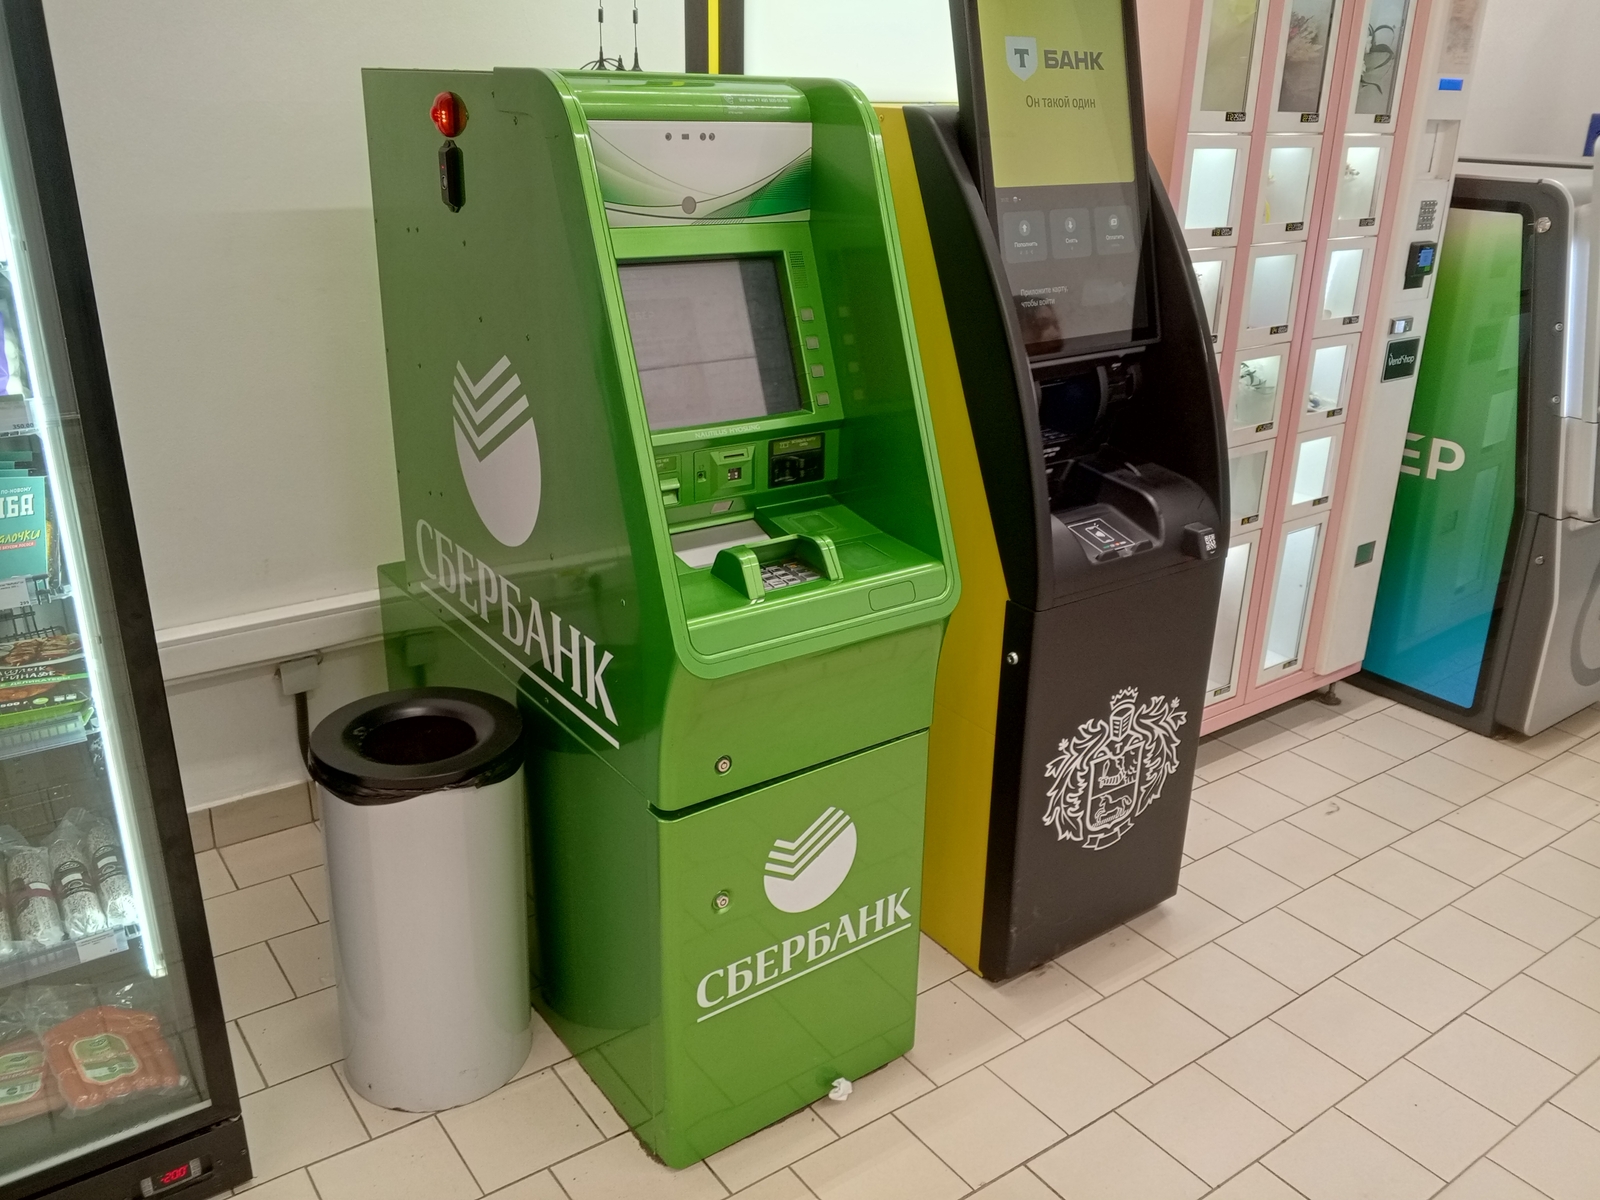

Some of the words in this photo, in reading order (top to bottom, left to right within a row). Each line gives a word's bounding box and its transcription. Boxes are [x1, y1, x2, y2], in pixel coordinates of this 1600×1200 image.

[1043, 49, 1104, 71] БАНК
[1025, 94, 1040, 108] Он
[1041, 95, 1070, 108] такой
[1072, 97, 1096, 110] один
[1020, 288, 1052, 297] Приложите
[1021, 299, 1039, 308] чтобы
[1039, 297, 1056, 306] войти
[694, 430, 728, 439] NAUTILUS
[729, 423, 761, 434] HYOSUNG
[0, 493, 34, 519] БА
[416, 518, 619, 727] СБЕРБАНК
[696, 887, 912, 1009] СБЕРБАНК
